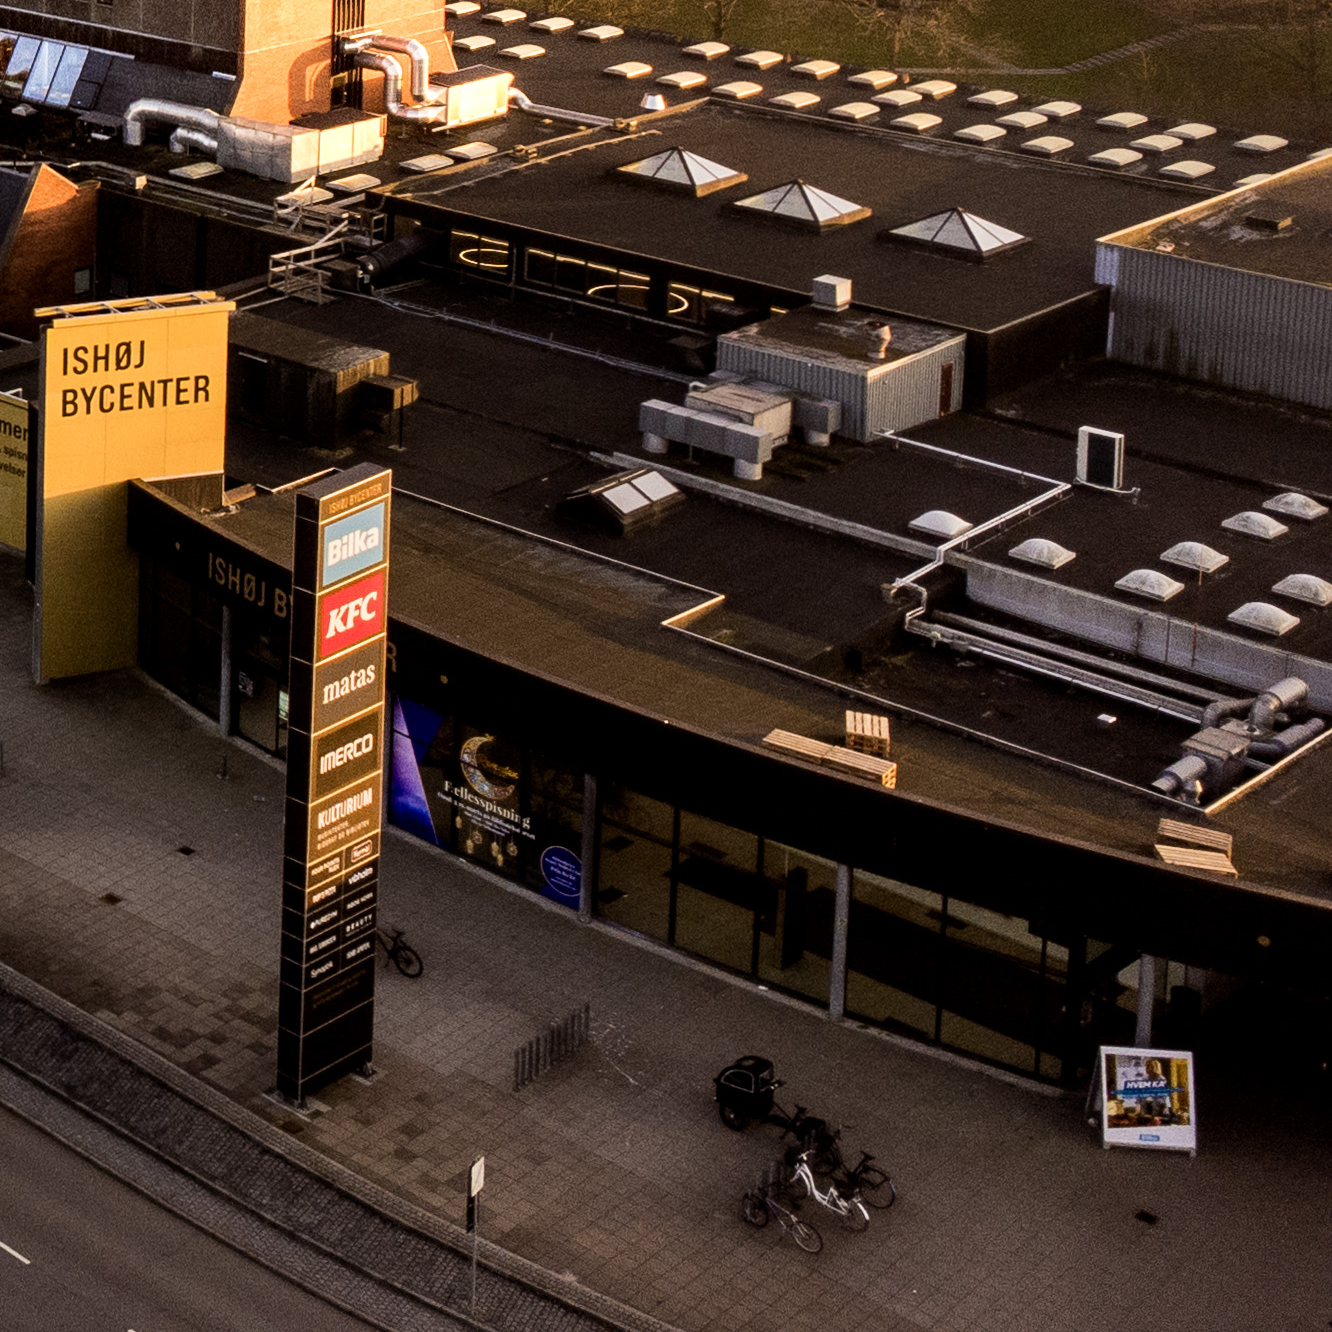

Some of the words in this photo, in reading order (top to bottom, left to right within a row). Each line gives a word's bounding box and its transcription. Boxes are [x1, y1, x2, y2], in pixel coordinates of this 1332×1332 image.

[63, 340, 145, 376] ISHØJ
[62, 375, 210, 418] BYCENTER
[349, 483, 382, 508] BYCENTER
[327, 526, 380, 567] Bilka
[208, 552, 266, 607] ISHØJ
[325, 591, 378, 639] KFC
[322, 664, 376, 705] matas
[320, 733, 374, 775] IMERCO
[318, 788, 373, 829] KULTURIUM
[1126, 1080, 1151, 1089] HVEM
